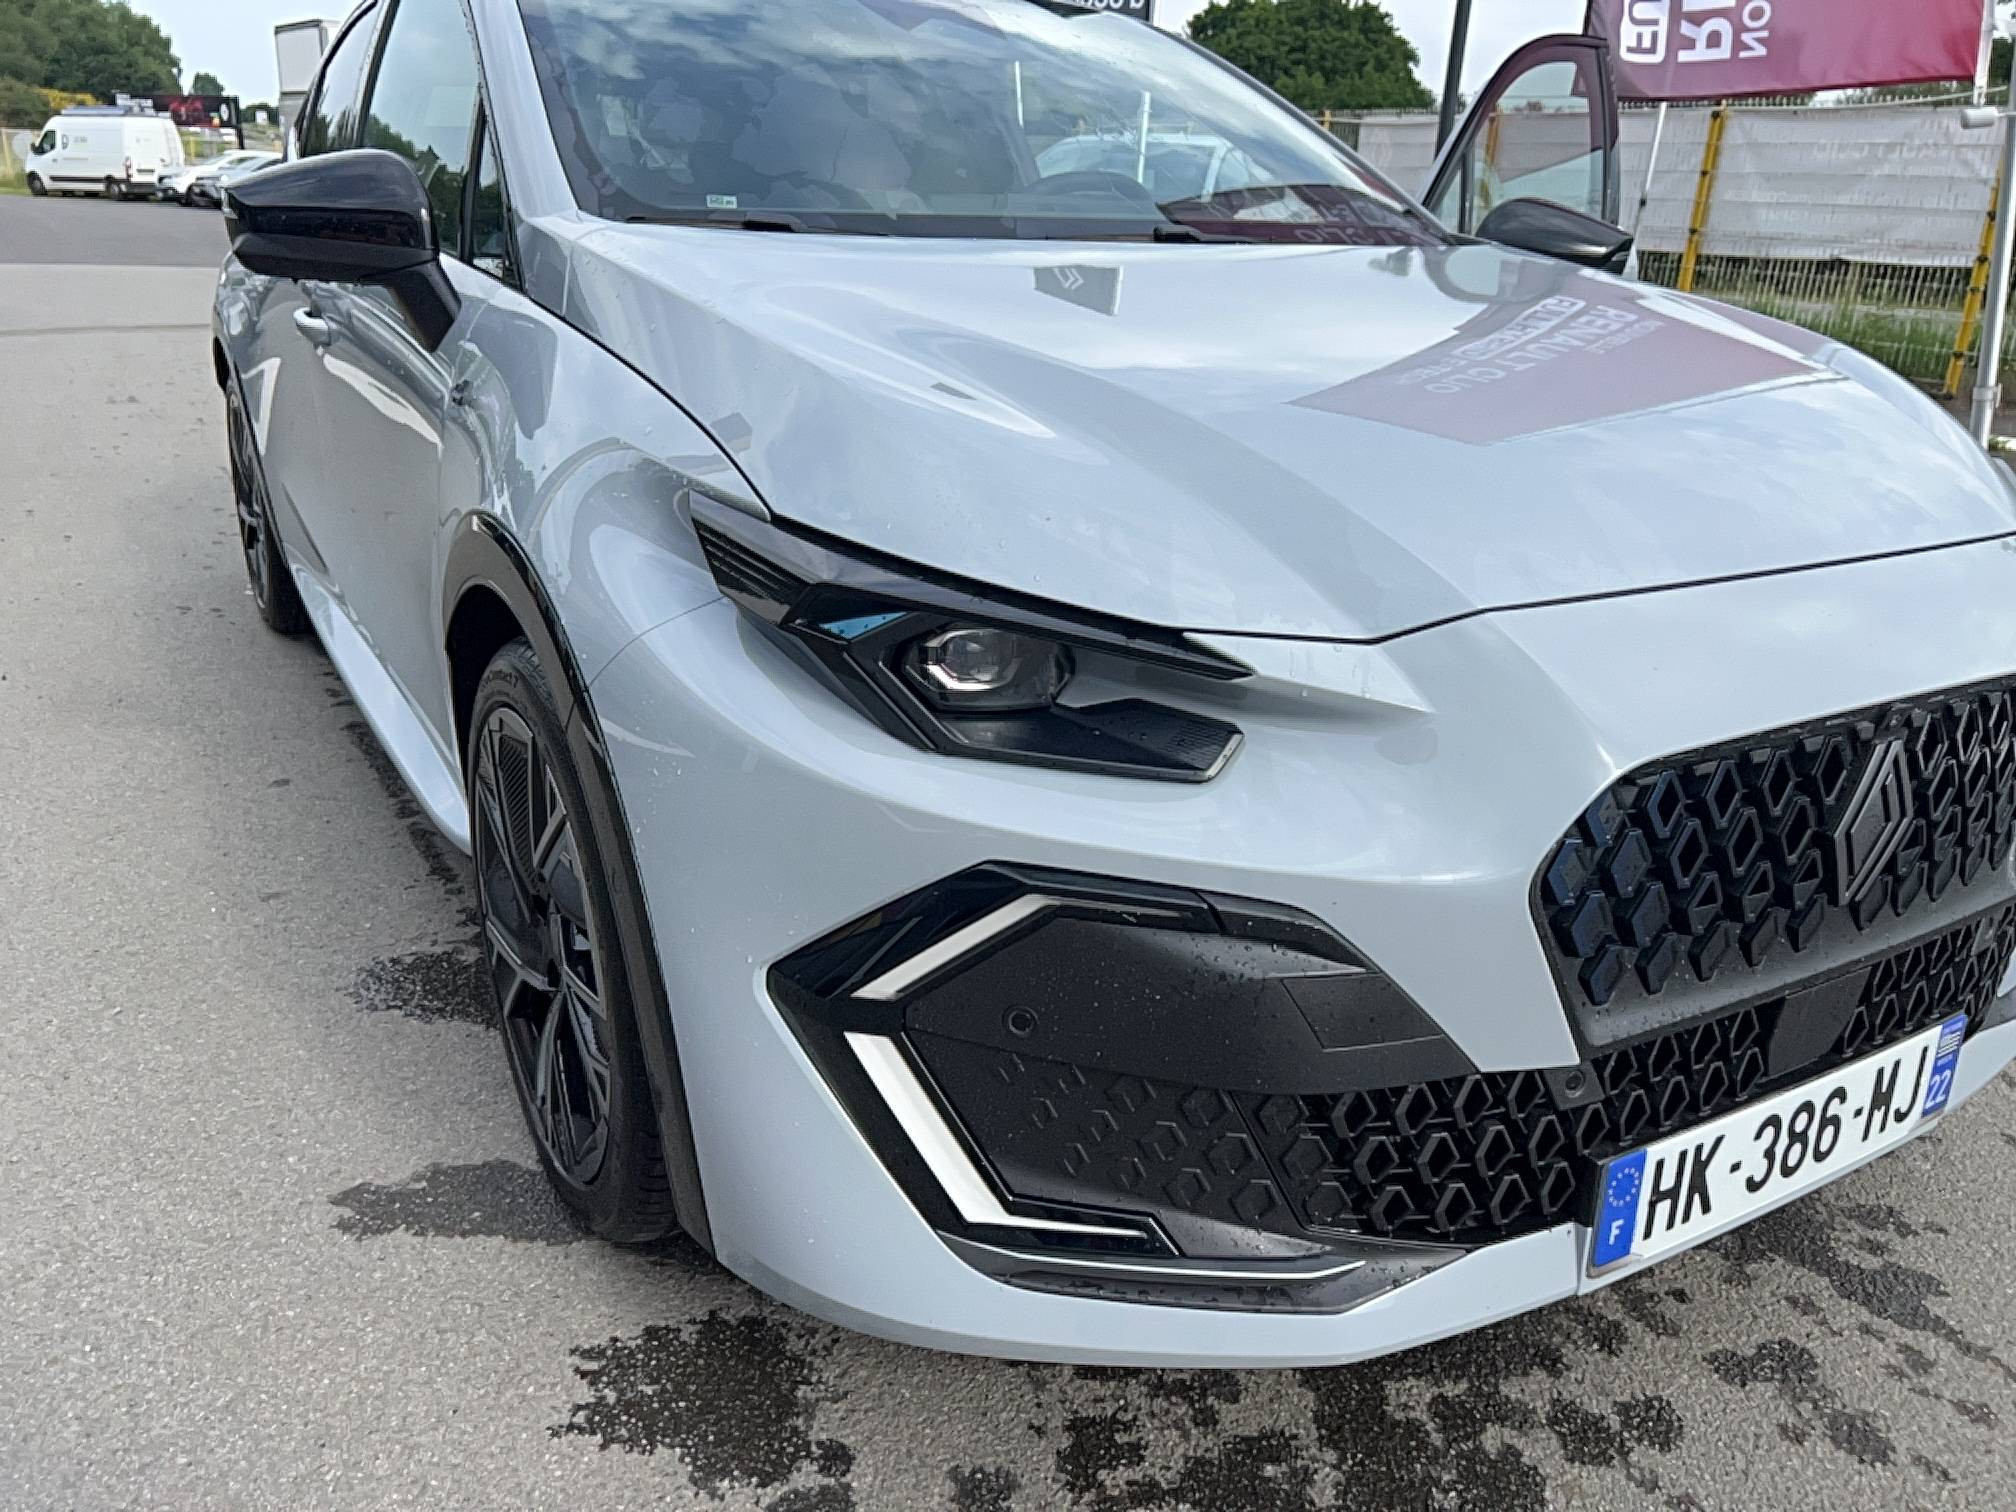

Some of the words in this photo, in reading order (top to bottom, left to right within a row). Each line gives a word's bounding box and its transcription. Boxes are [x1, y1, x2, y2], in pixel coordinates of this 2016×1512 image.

[1496, 304, 1639, 372] RENAULT
[1423, 366, 1508, 394] CLIO
[1925, 1069, 1951, 1109] 22
[1608, 1218, 1624, 1246] F
[1643, 1045, 1928, 1240] HK-386-MJ
